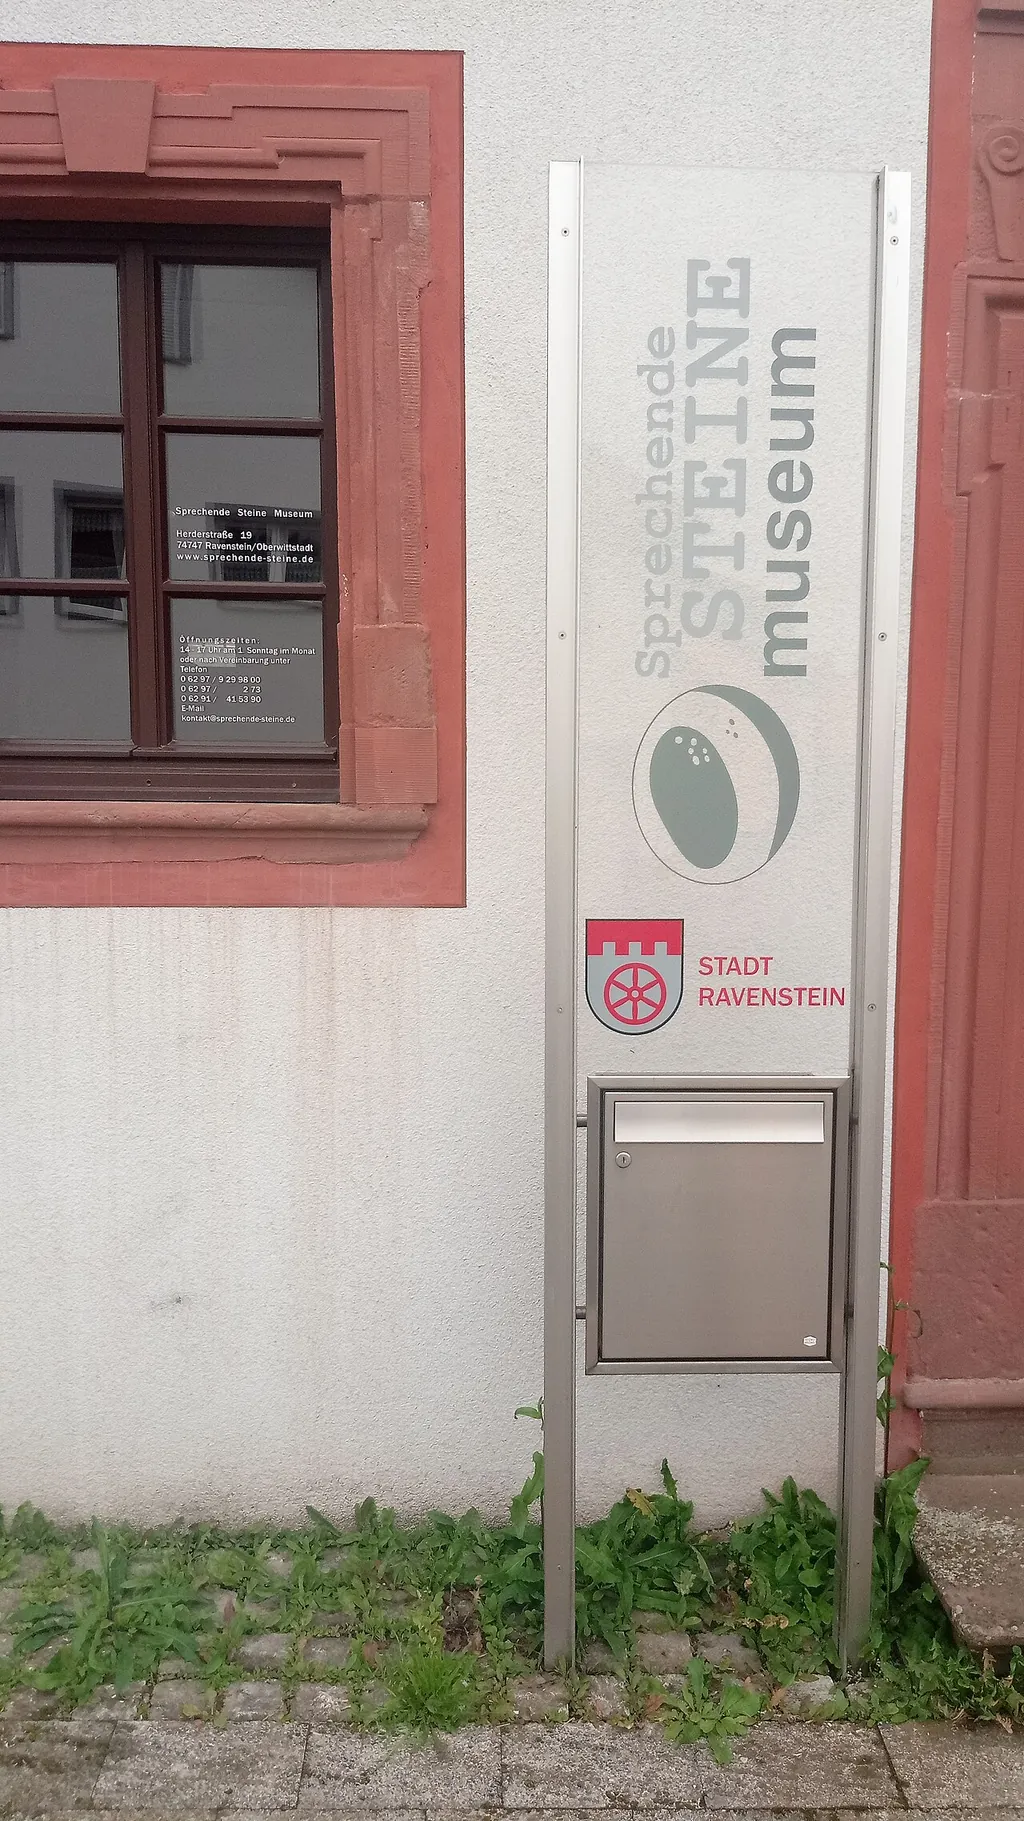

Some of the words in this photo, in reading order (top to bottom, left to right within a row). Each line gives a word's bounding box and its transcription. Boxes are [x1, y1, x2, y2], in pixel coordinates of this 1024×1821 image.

[680, 257, 751, 641] STEINE
[634, 326, 682, 678] Sprechende
[763, 328, 817, 677] museum
[176, 507, 230, 516] Sprechende
[238, 508, 266, 517] Steine
[274, 510, 313, 518] Museum
[176, 530, 233, 539] Herderstraße
[240, 531, 252, 539] 19
[177, 541, 202, 549] 74747
[206, 542, 314, 552] Ravenstein/Oberwittstadt
[177, 553, 314, 563] www.sprechende-steine.de
[180, 635, 260, 644] Öffnungszeiten:
[247, 647, 278, 655] Sonntag
[220, 657, 268, 665] Vereinbarung
[182, 715, 295, 723] kontakt@sprechende-steine.de
[698, 956, 774, 976] STADT
[698, 987, 846, 1007] RAVENSTEIN
